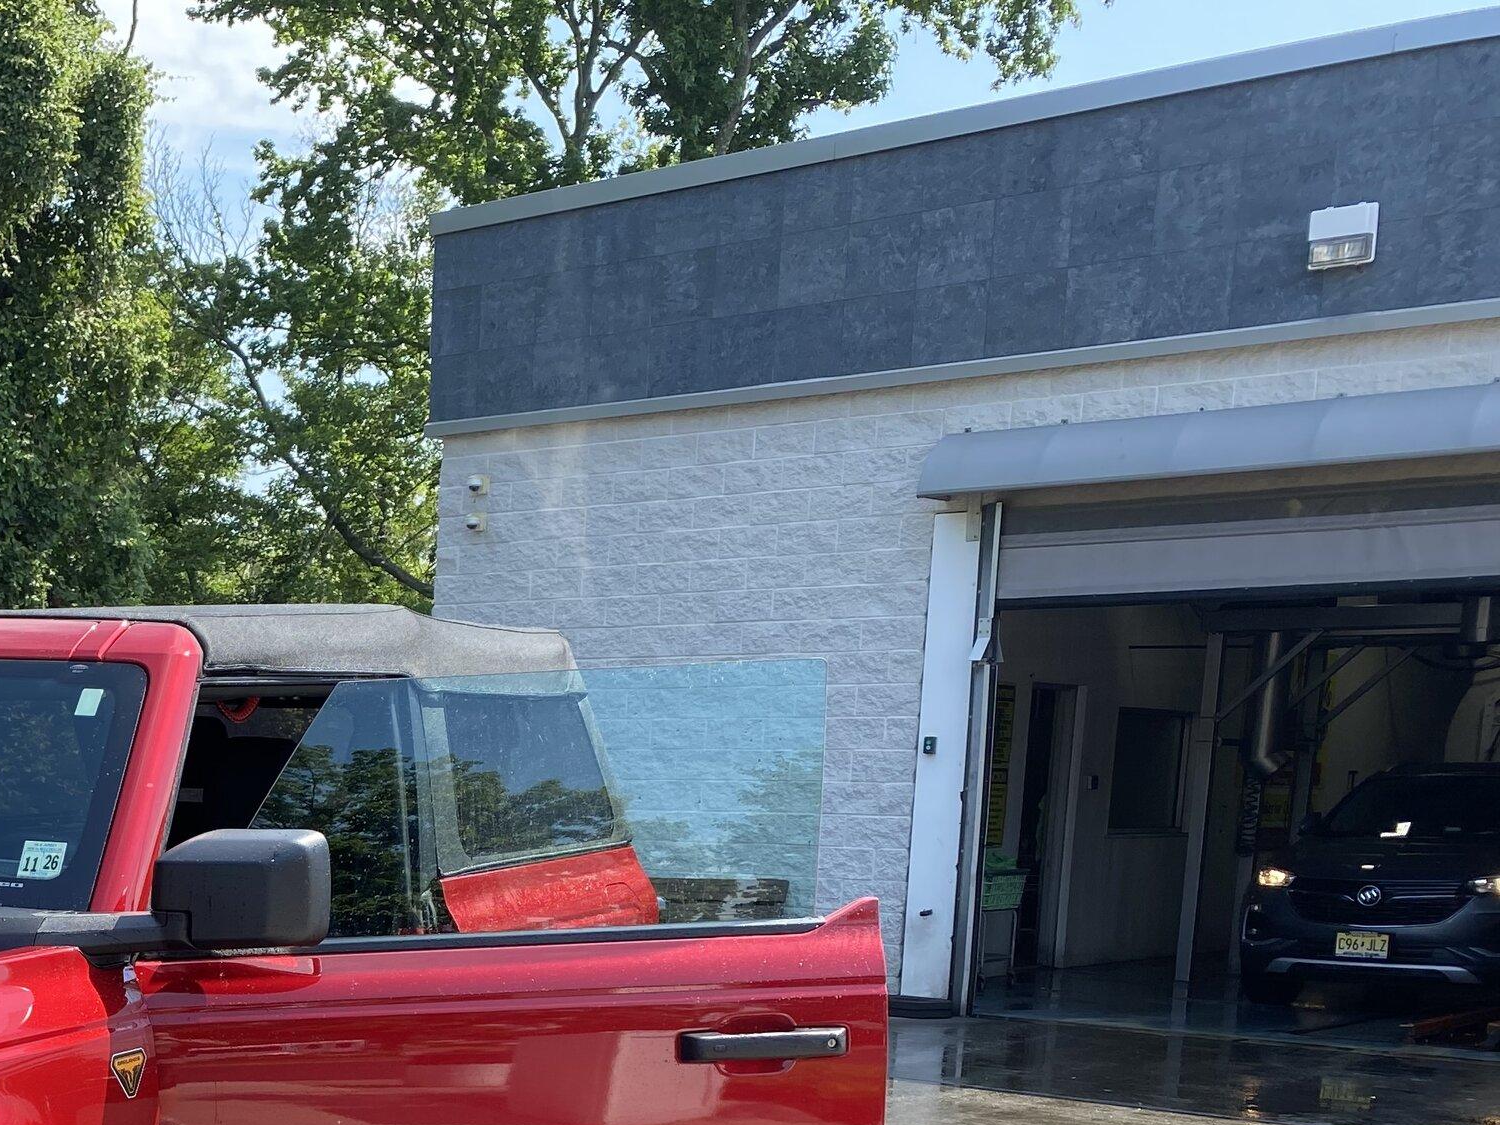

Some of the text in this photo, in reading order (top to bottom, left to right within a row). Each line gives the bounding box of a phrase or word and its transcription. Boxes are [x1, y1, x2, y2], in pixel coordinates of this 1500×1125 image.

[23, 855, 60, 872] 11 26
[1339, 938, 1358, 951] C96
